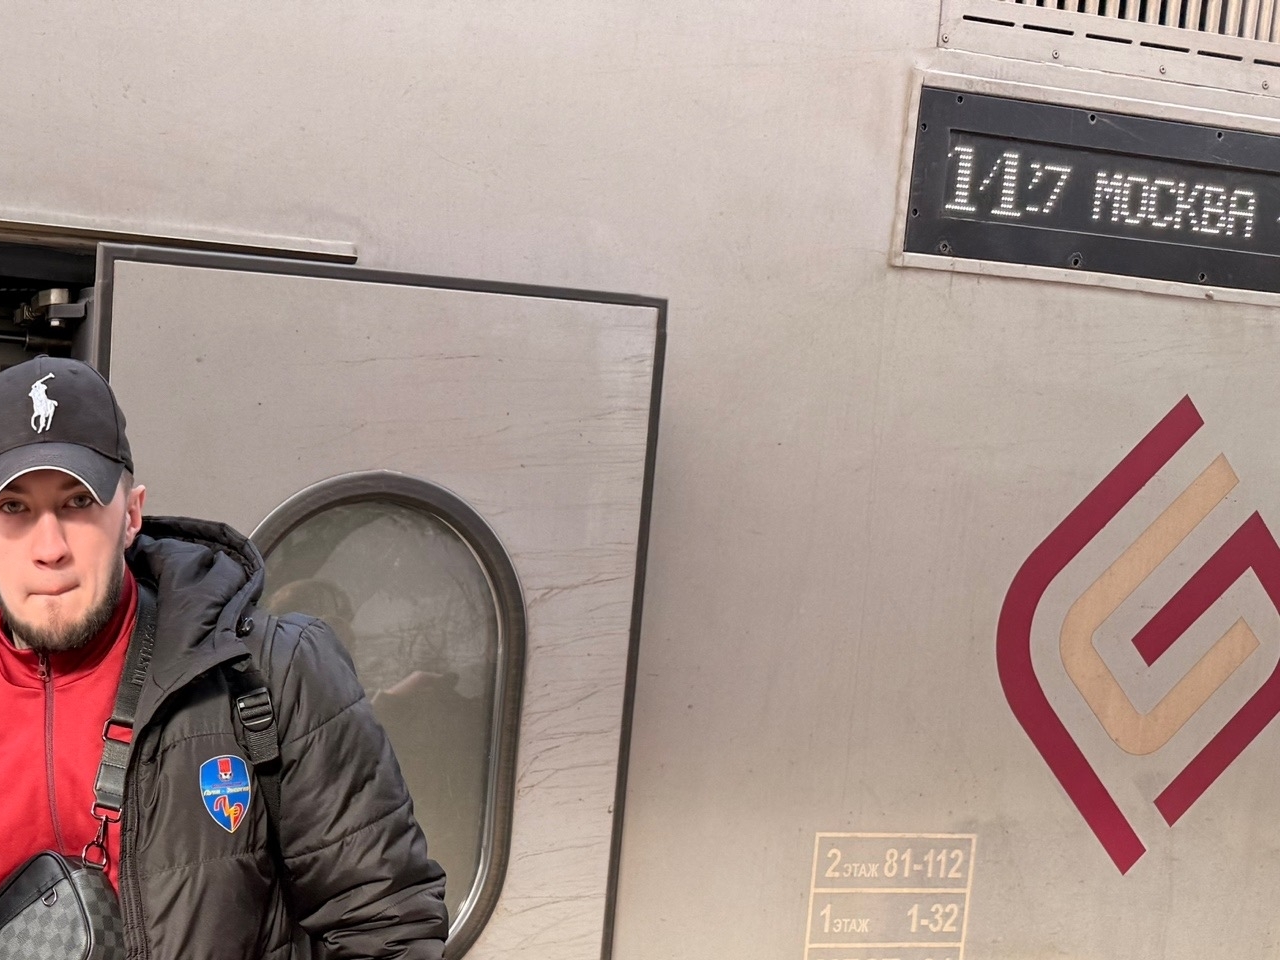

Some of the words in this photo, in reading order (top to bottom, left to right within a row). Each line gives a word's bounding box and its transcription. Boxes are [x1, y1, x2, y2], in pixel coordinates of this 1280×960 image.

[1092, 171, 1256, 239] МОСКВА
[884, 848, 964, 879] 81-112
[907, 903, 959, 933] 1-32
